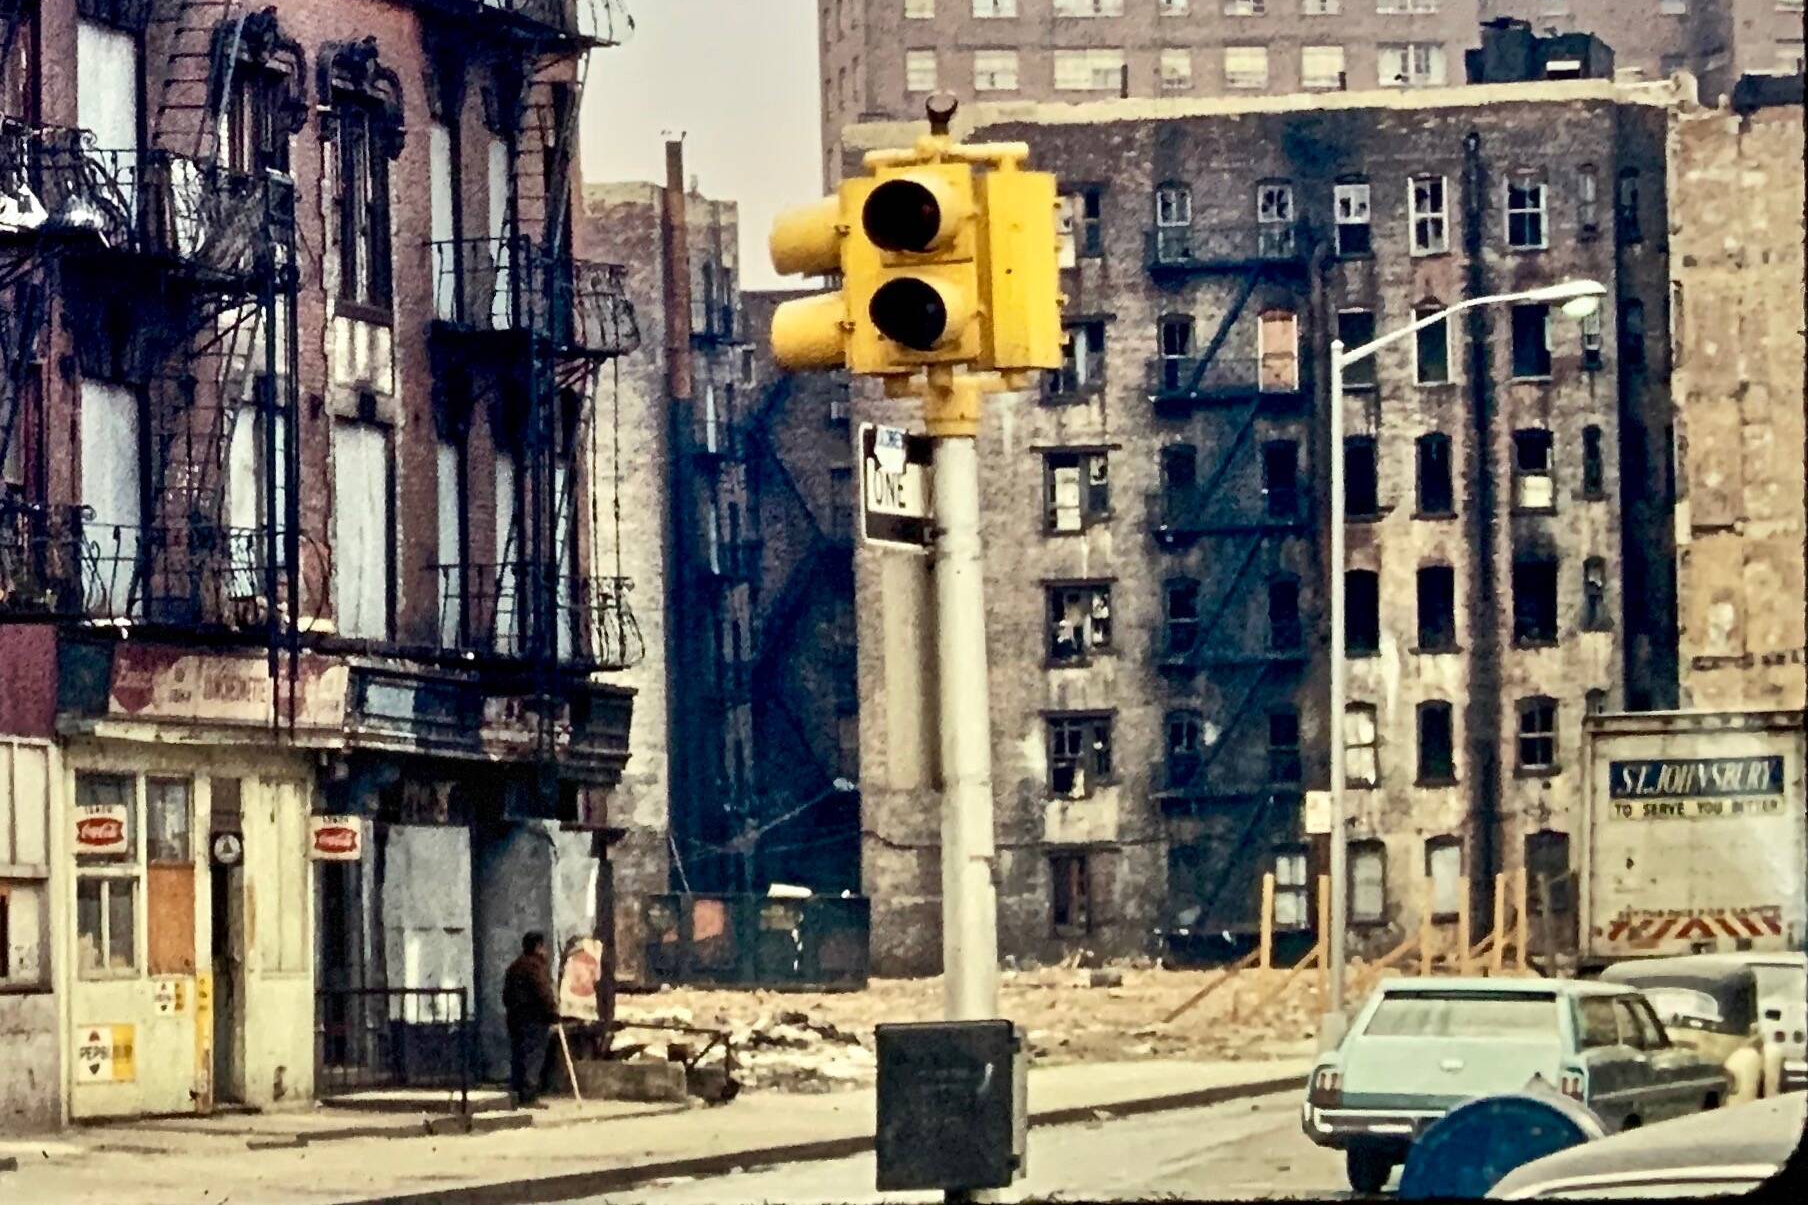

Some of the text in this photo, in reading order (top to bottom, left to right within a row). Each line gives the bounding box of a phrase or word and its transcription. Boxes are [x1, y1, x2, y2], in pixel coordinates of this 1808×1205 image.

[873, 470, 907, 509] ONE
[1615, 804, 1632, 818] TO
[1642, 802, 1685, 816] SERVE
[1698, 802, 1723, 816] YOU
